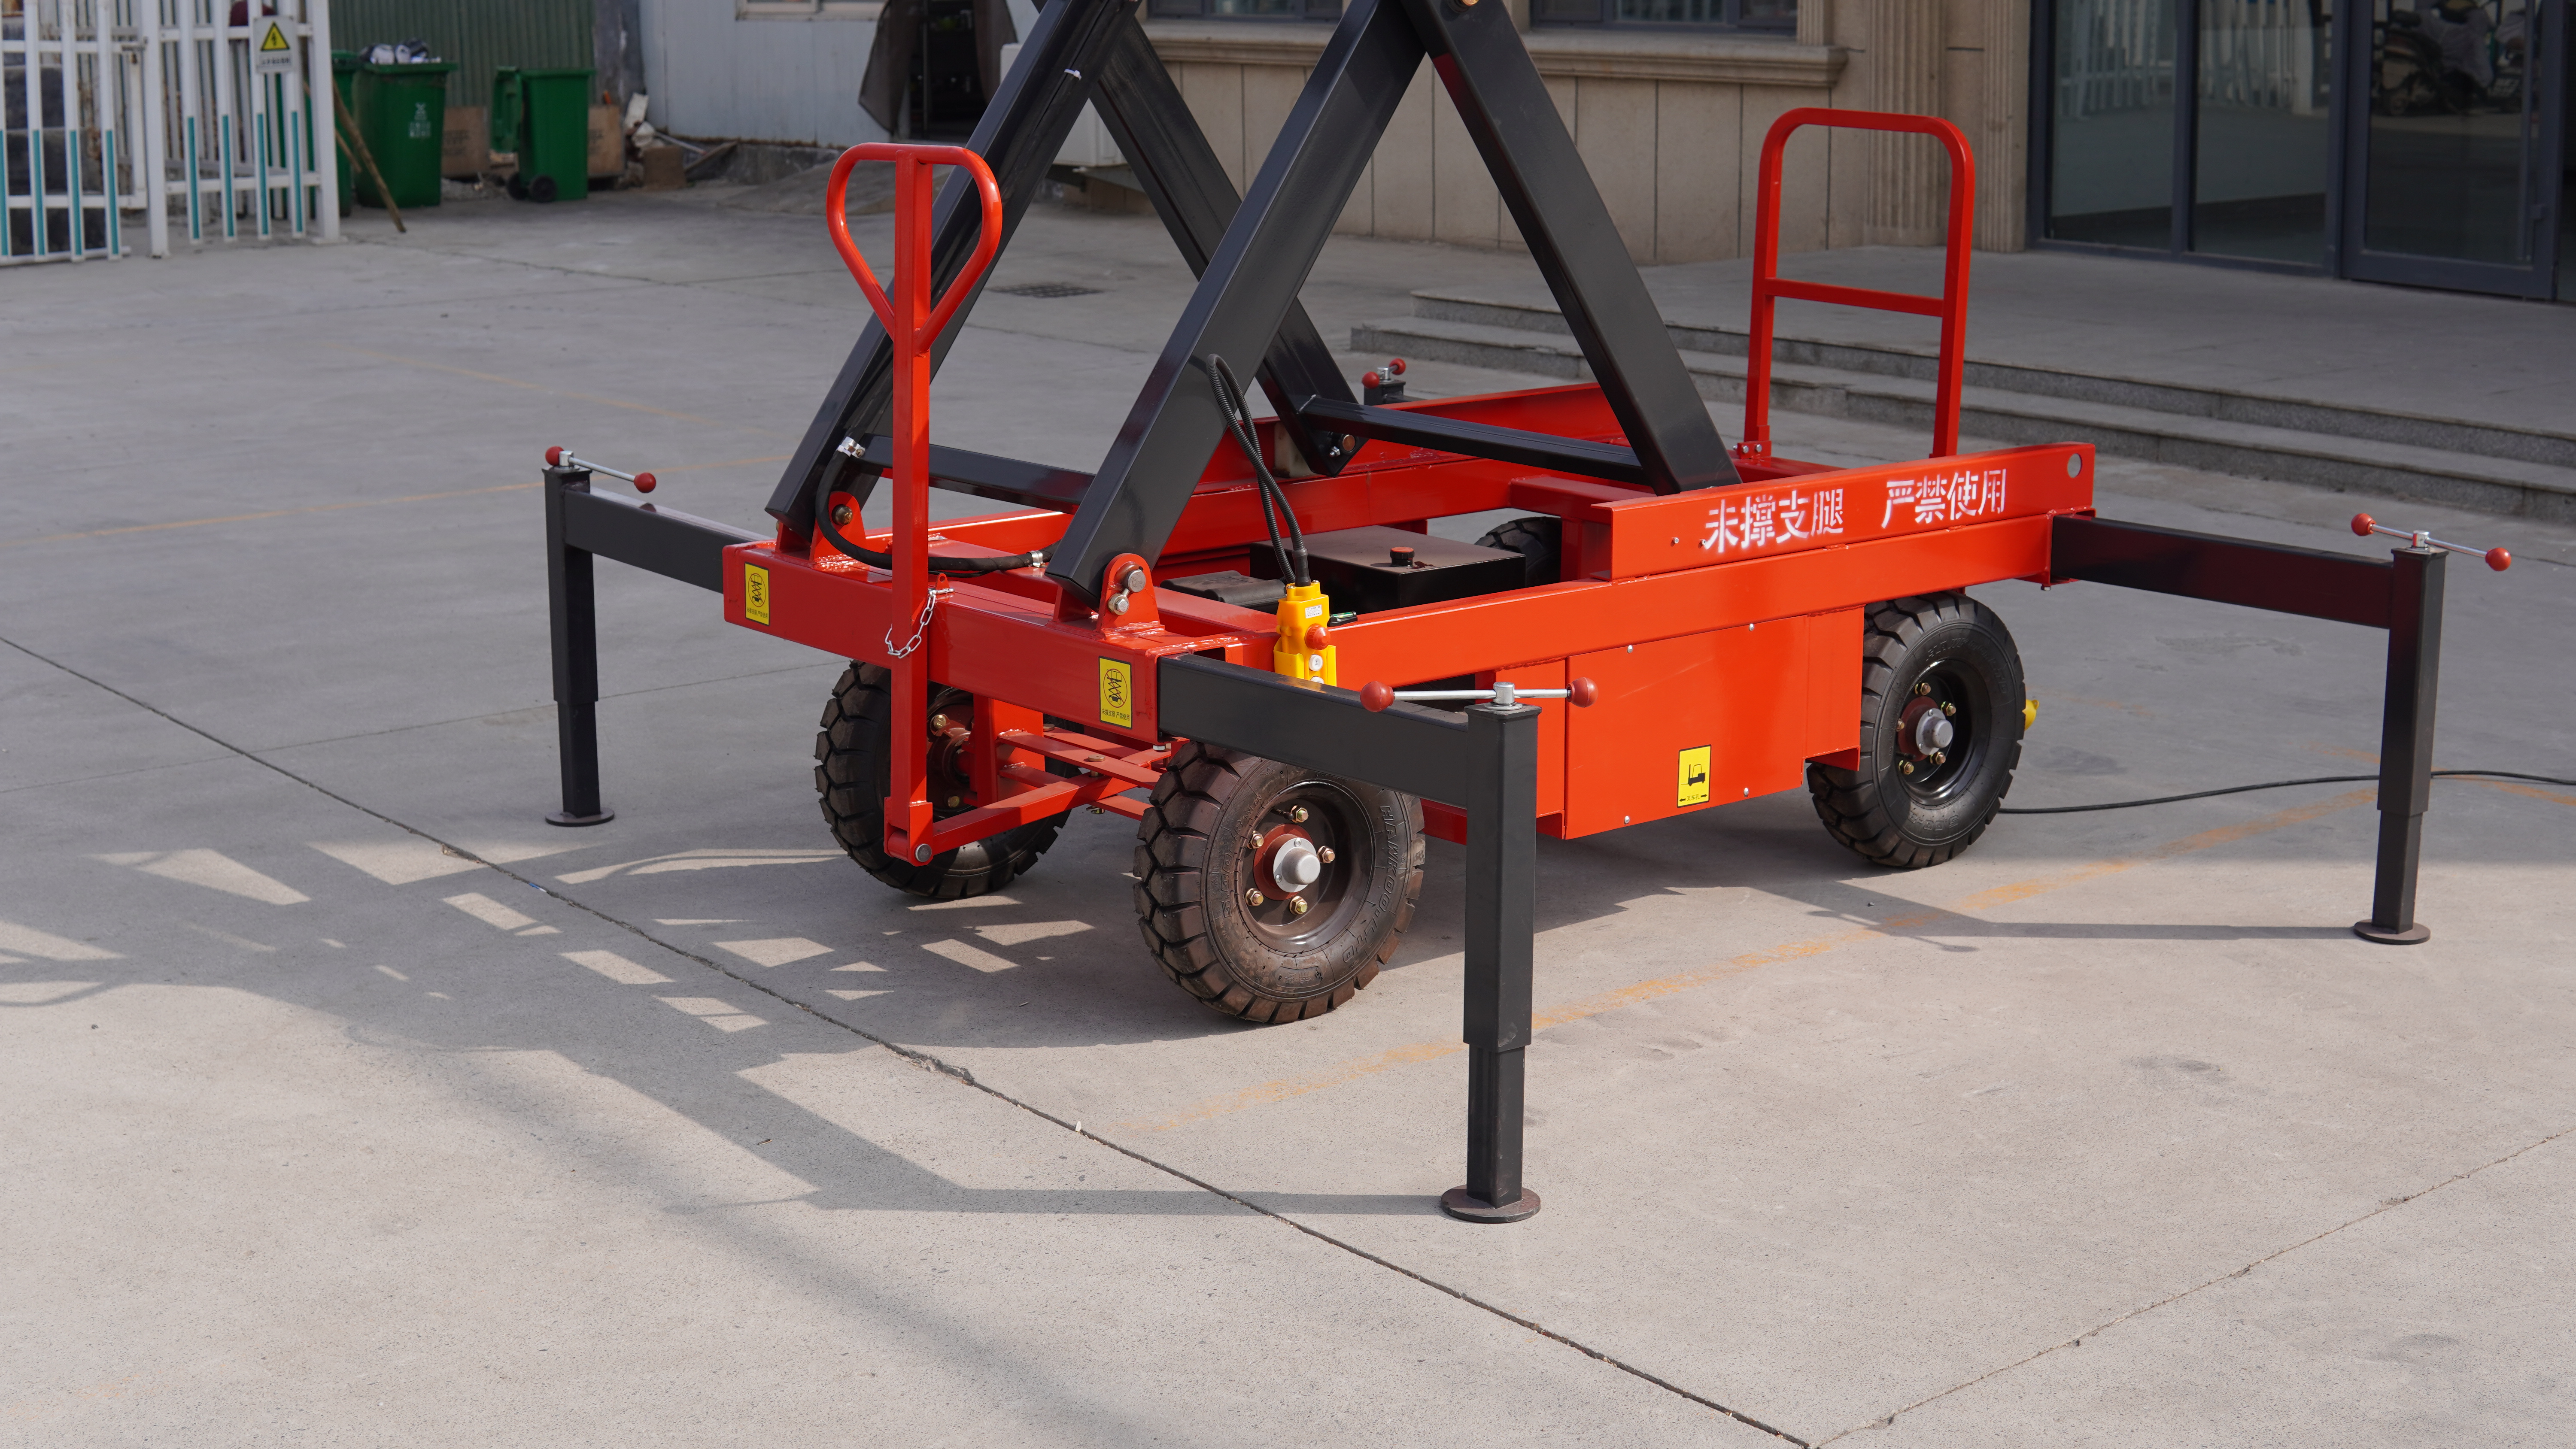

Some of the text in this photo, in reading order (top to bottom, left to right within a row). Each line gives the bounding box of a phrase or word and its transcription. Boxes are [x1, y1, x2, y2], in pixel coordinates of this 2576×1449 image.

[1704, 469, 2007, 553] 未撑支腿 严禁使用
